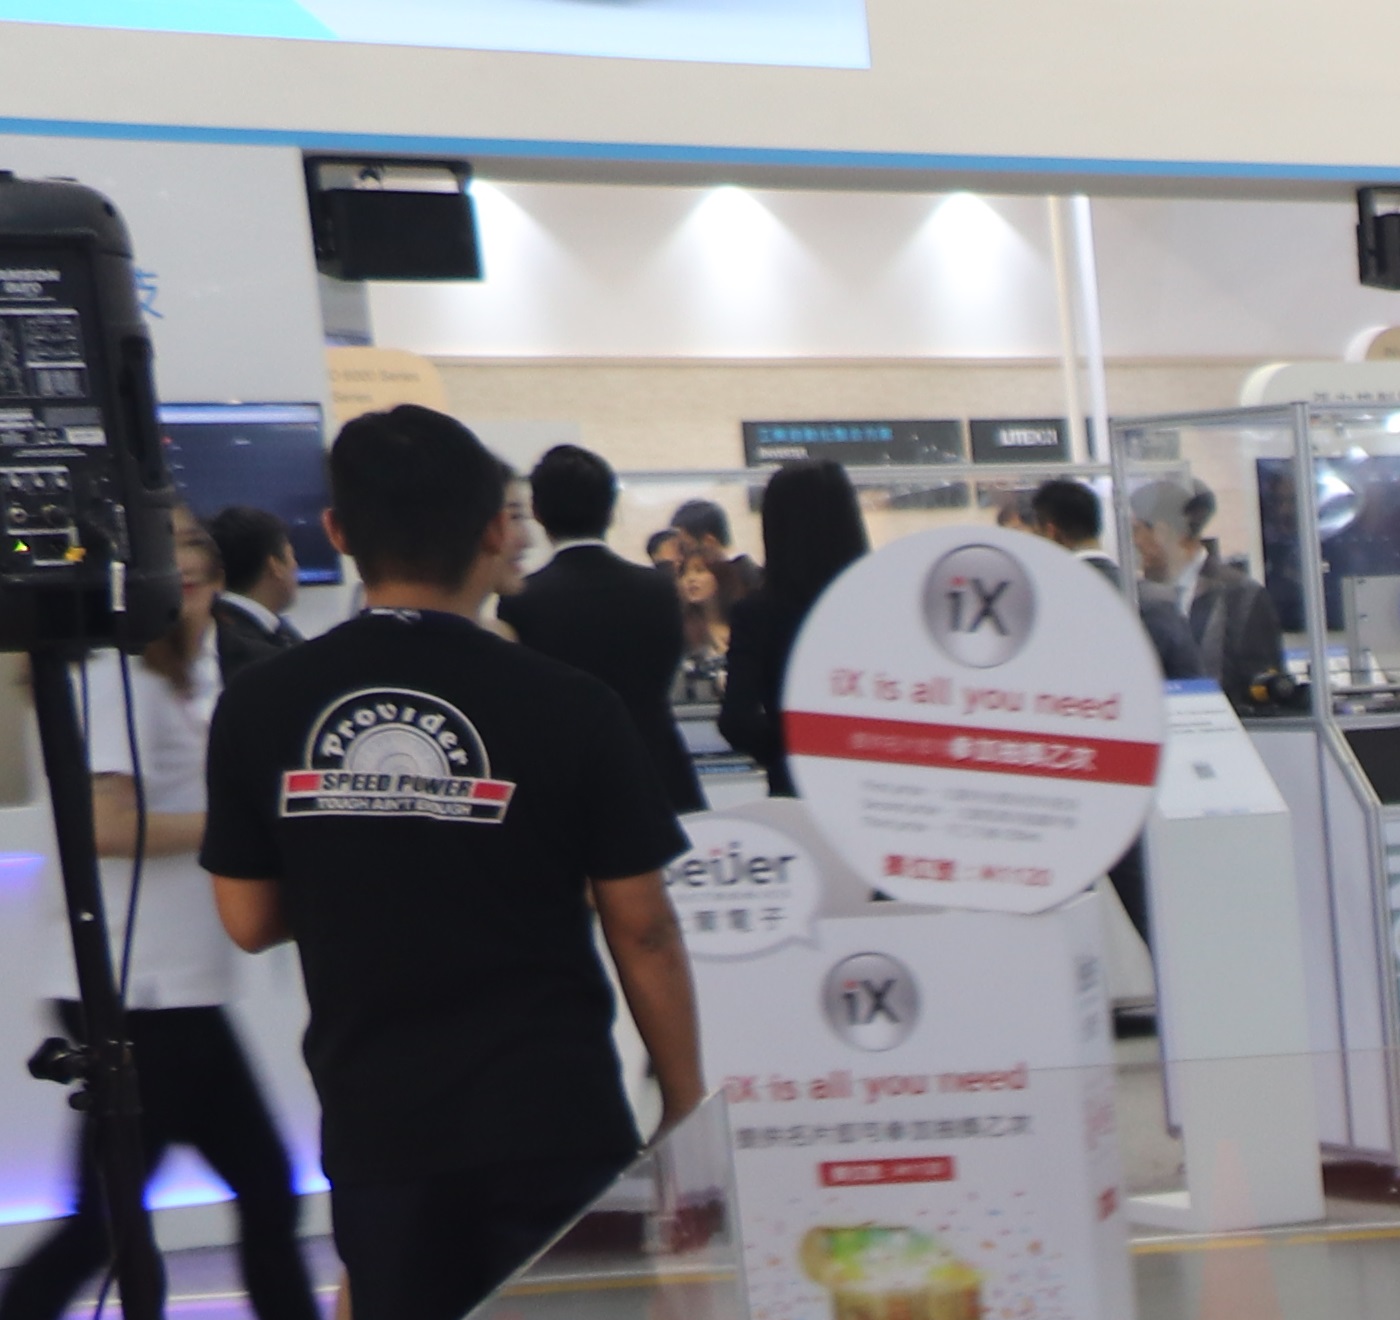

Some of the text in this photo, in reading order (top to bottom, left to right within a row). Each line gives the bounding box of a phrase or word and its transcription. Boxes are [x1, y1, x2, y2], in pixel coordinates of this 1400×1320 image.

[946, 576, 1010, 637] iX
[873, 672, 898, 701] is
[909, 675, 952, 706] all
[961, 687, 1024, 715] you
[1033, 692, 1121, 721] need
[322, 703, 469, 766] Provider
[323, 772, 472, 798] SPEED POWER
[841, 976, 900, 1026] iX
[809, 1069, 852, 1100] all
[862, 1075, 928, 1104] you
[939, 1062, 1028, 1092] need
